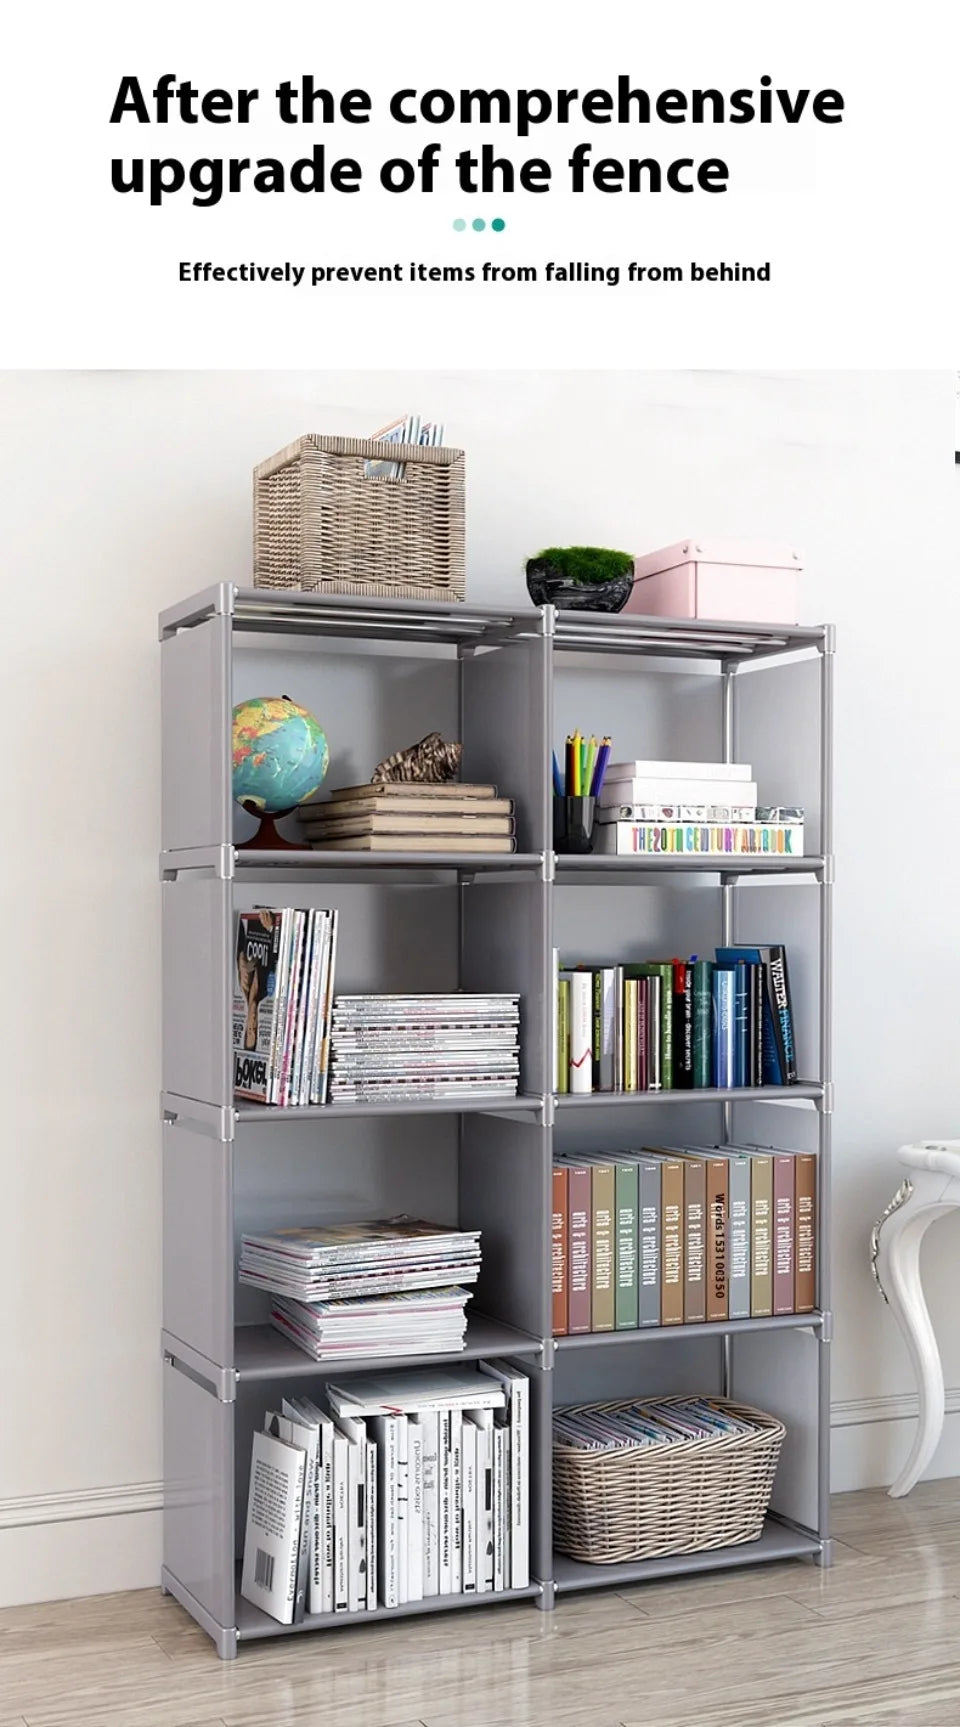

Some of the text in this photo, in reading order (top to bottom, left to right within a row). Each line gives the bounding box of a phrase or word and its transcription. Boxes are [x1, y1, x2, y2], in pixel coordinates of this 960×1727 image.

[770, 957, 788, 1009] WALTER
[295, 1465, 304, 1488] love
[293, 1496, 301, 1521] with
[302, 1501, 311, 1526] and
[287, 1540, 298, 1602] Evermotion
